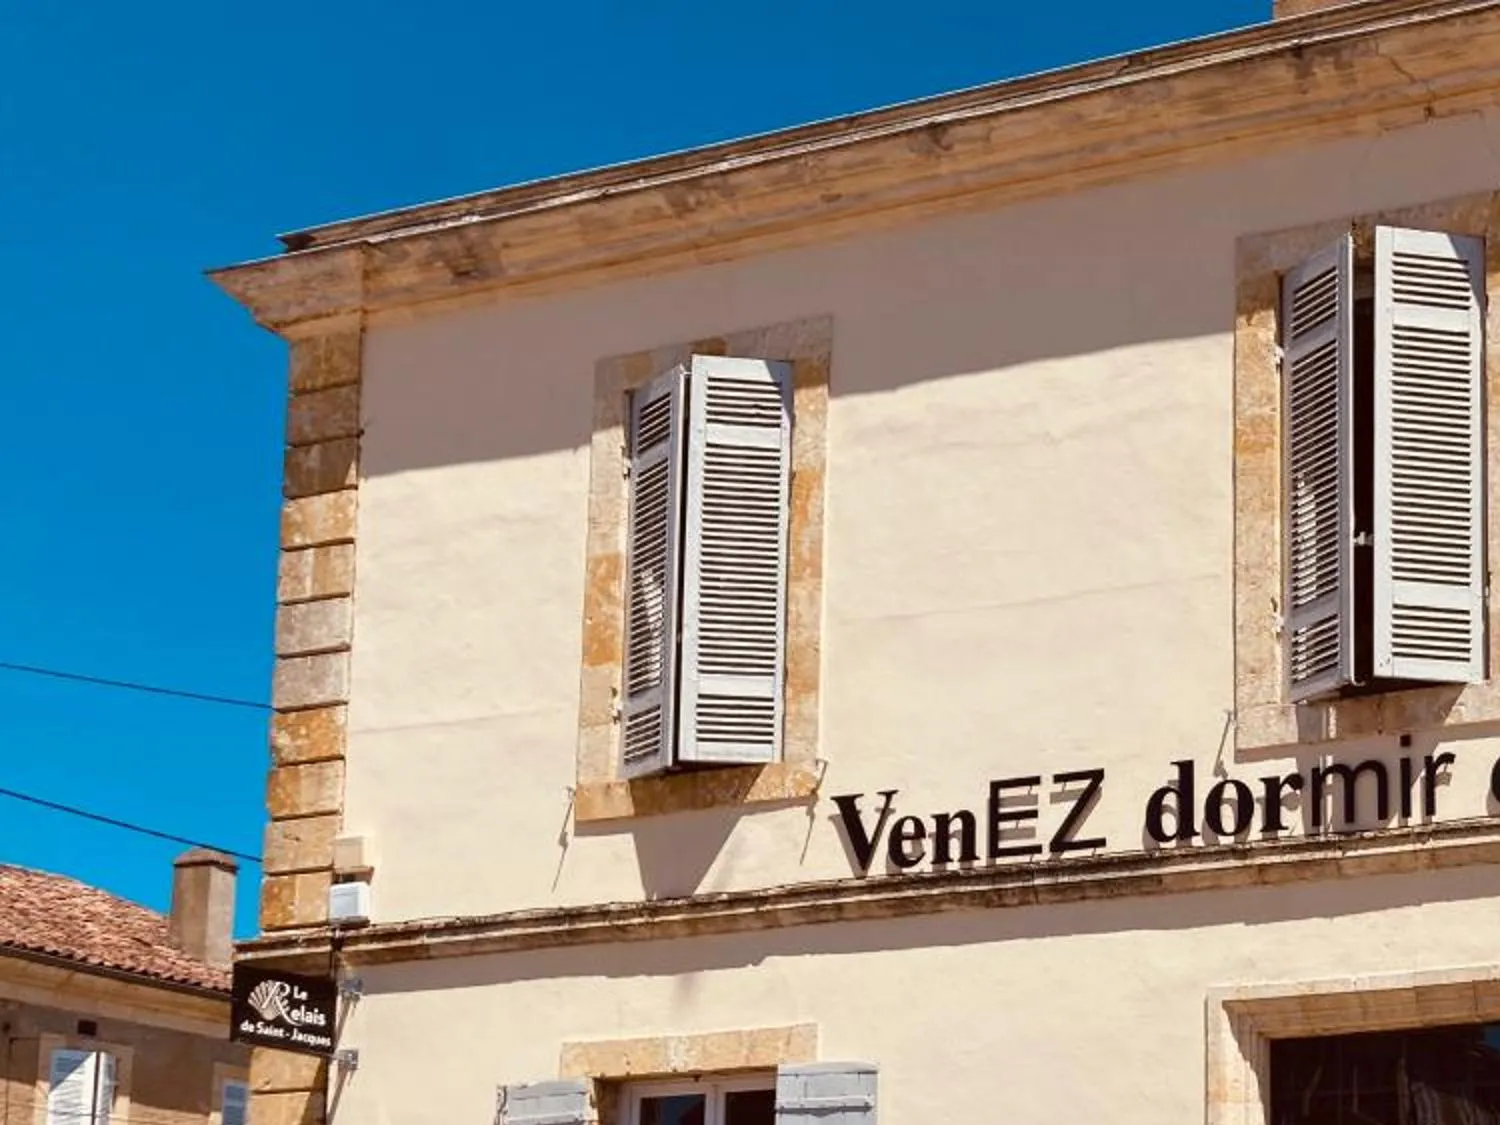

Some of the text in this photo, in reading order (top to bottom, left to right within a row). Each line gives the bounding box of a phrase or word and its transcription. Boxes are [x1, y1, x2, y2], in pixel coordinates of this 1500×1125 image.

[830, 768, 1105, 876] VenEZ
[1144, 733, 1456, 844] dormir
[293, 985, 308, 1000] Le
[240, 1019, 255, 1033] de
[256, 1021, 285, 1038] Saint
[291, 1027, 331, 1047] Jacques
